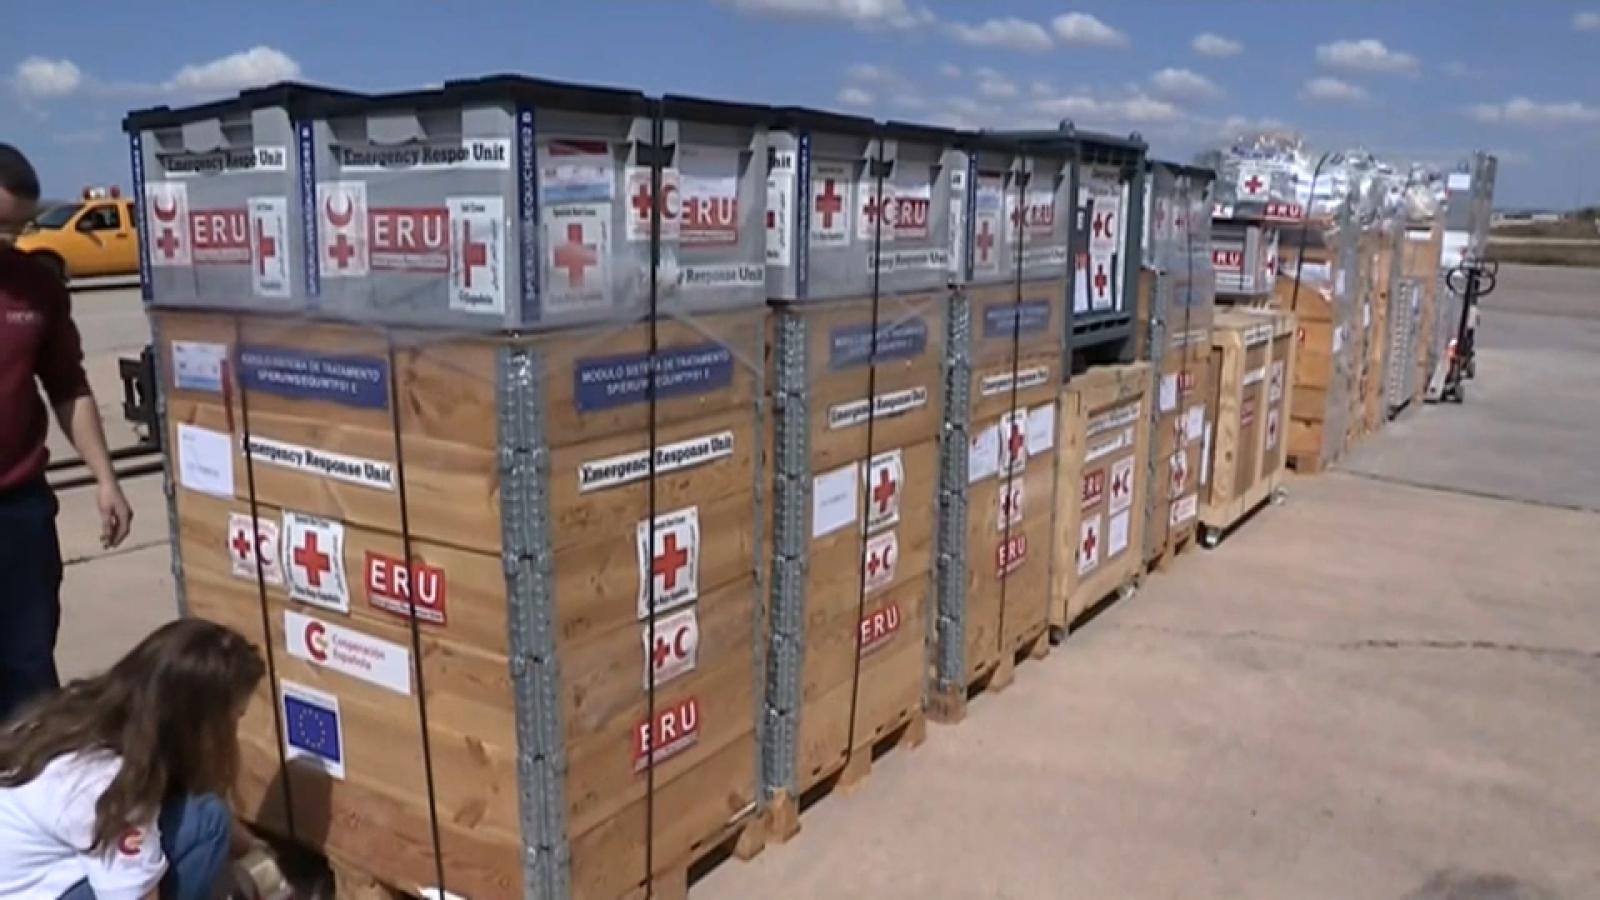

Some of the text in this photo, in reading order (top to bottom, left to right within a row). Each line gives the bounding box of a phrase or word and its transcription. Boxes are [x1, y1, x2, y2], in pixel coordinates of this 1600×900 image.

[259, 149, 283, 166] Unit
[472, 143, 505, 161] Unit
[193, 214, 246, 245] ERU
[373, 214, 443, 248] ERU
[710, 436, 732, 452] Unit
[305, 450, 362, 476] Response
[364, 462, 392, 483] Unit
[371, 559, 438, 604] ERU
[861, 604, 899, 644] ERU
[639, 701, 697, 753] ERU
